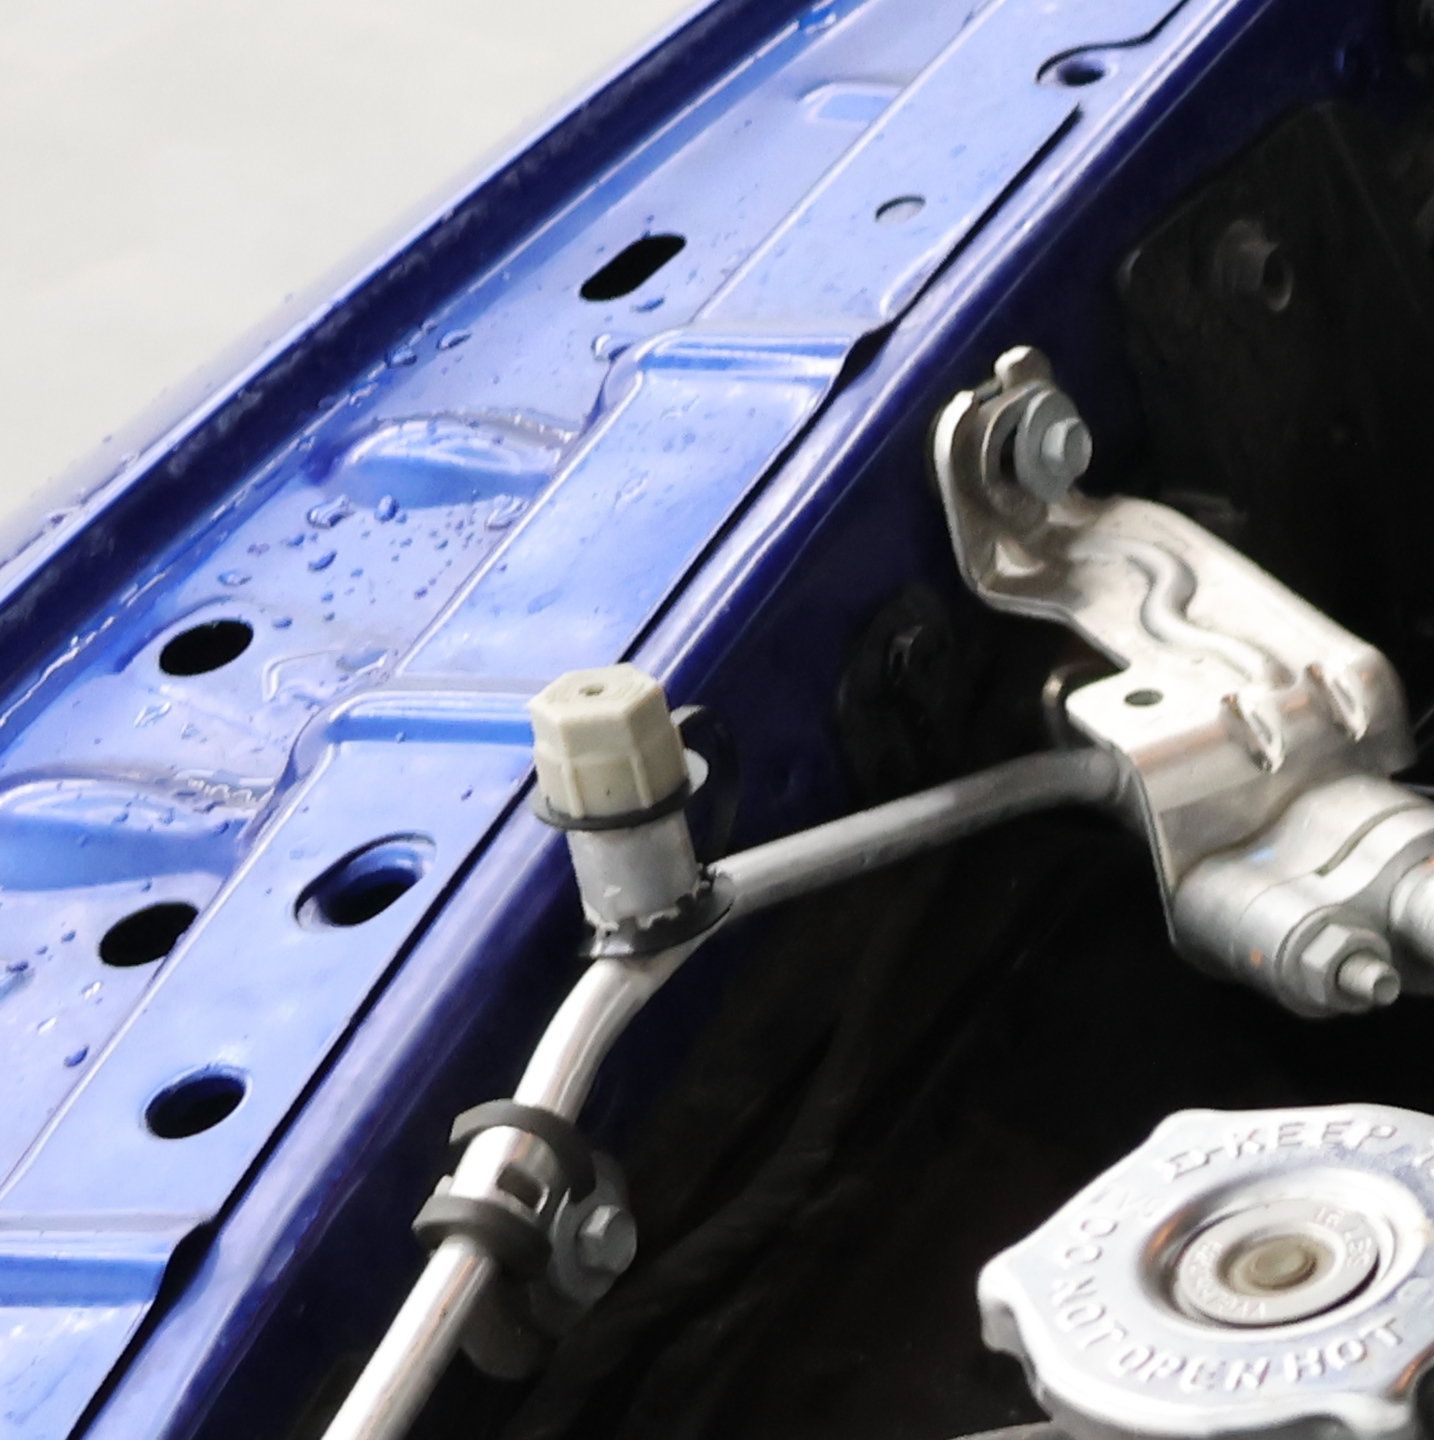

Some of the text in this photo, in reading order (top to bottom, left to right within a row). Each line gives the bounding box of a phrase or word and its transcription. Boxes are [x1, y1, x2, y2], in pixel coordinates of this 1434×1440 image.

[1217, 1120, 1398, 1161] KEEP
[1050, 1274, 1129, 1351] NOT
[1112, 1344, 1271, 1392] OPEN
[1284, 1317, 1406, 1383] HOT
